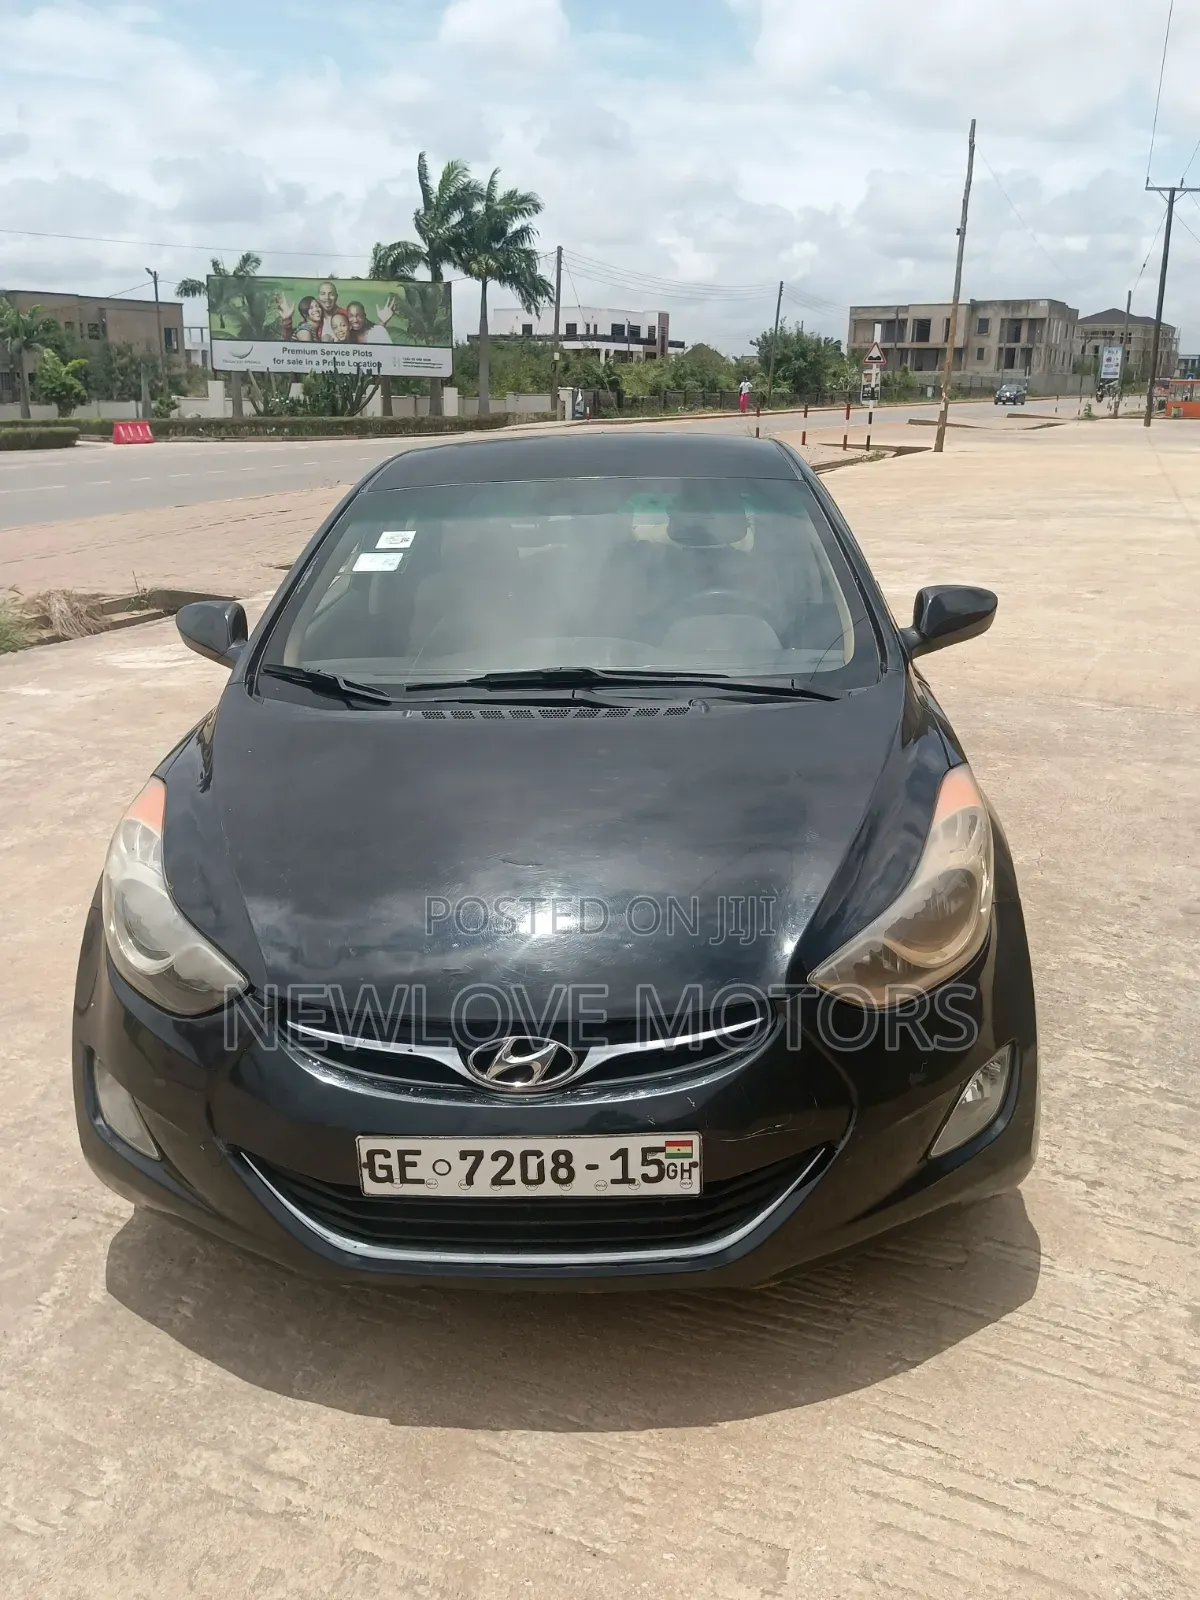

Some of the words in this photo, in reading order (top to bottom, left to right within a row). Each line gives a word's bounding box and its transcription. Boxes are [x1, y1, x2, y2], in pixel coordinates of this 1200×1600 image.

[282, 347, 318, 355] Premium
[320, 348, 350, 357] Service
[352, 349, 373, 357] Plots
[287, 358, 304, 366] sale
[365, 1149, 426, 1185] GE
[666, 1159, 693, 1180] GH
